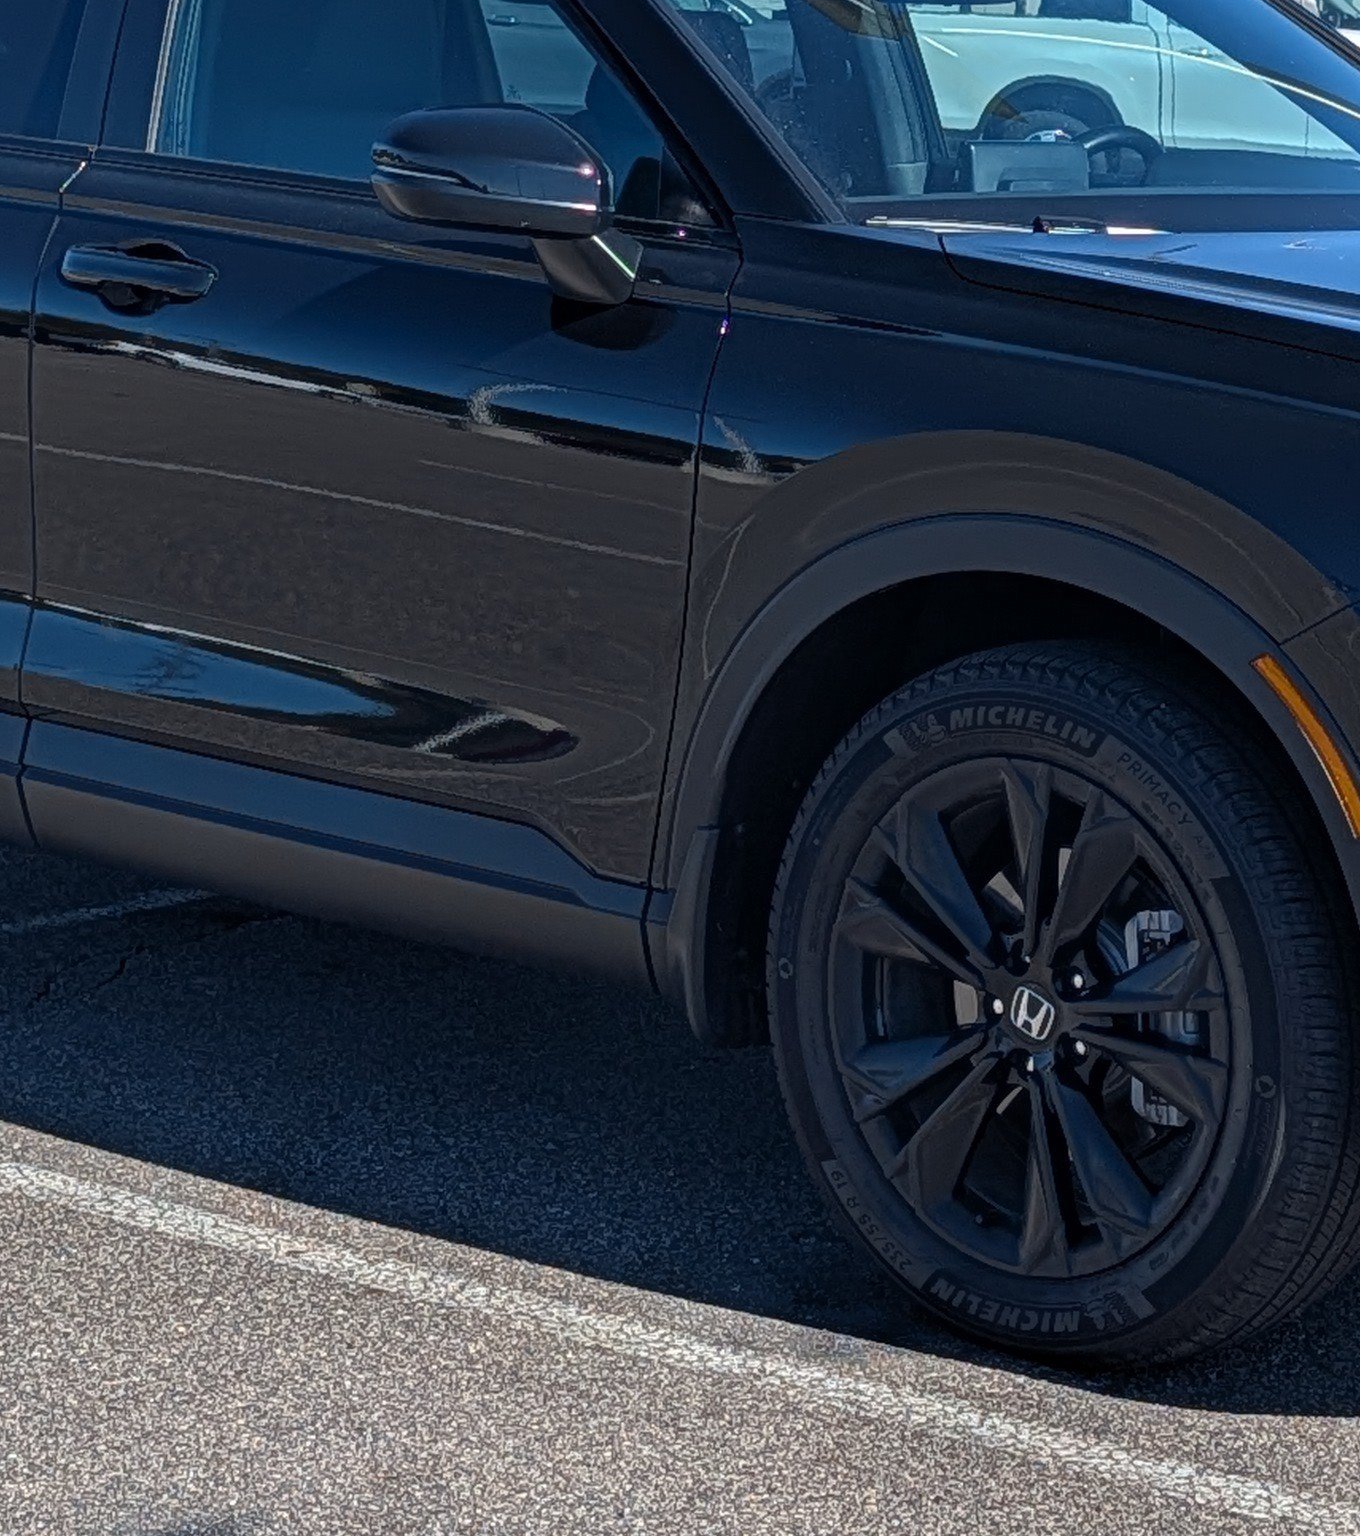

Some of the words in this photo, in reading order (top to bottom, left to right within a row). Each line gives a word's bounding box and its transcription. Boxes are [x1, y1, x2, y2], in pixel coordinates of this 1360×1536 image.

[949, 704, 1097, 750] MICHELIN
[1117, 751, 1195, 827] PRIMACY
[829, 1169, 845, 1190] 19
[929, 1277, 1081, 1333] MICHELIN
